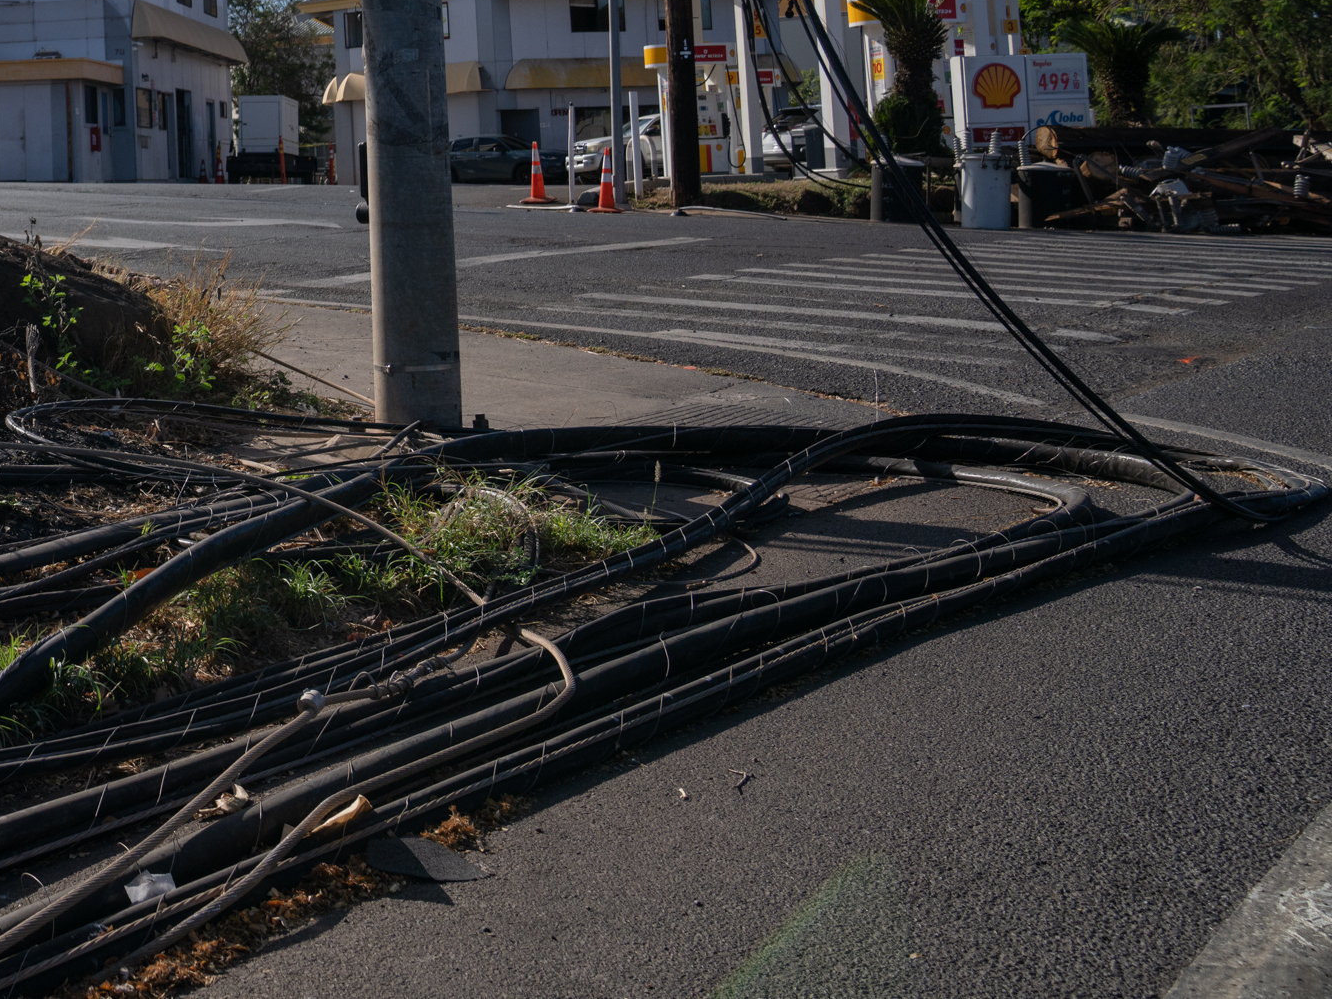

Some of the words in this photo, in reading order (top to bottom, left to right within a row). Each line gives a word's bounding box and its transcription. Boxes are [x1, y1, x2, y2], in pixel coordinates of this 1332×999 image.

[755, 25, 761, 35] 5
[1008, 21, 1014, 31] 3
[1032, 60, 1053, 69] Regular
[1038, 72, 1070, 91] 499
[1036, 110, 1085, 127] Aloha
